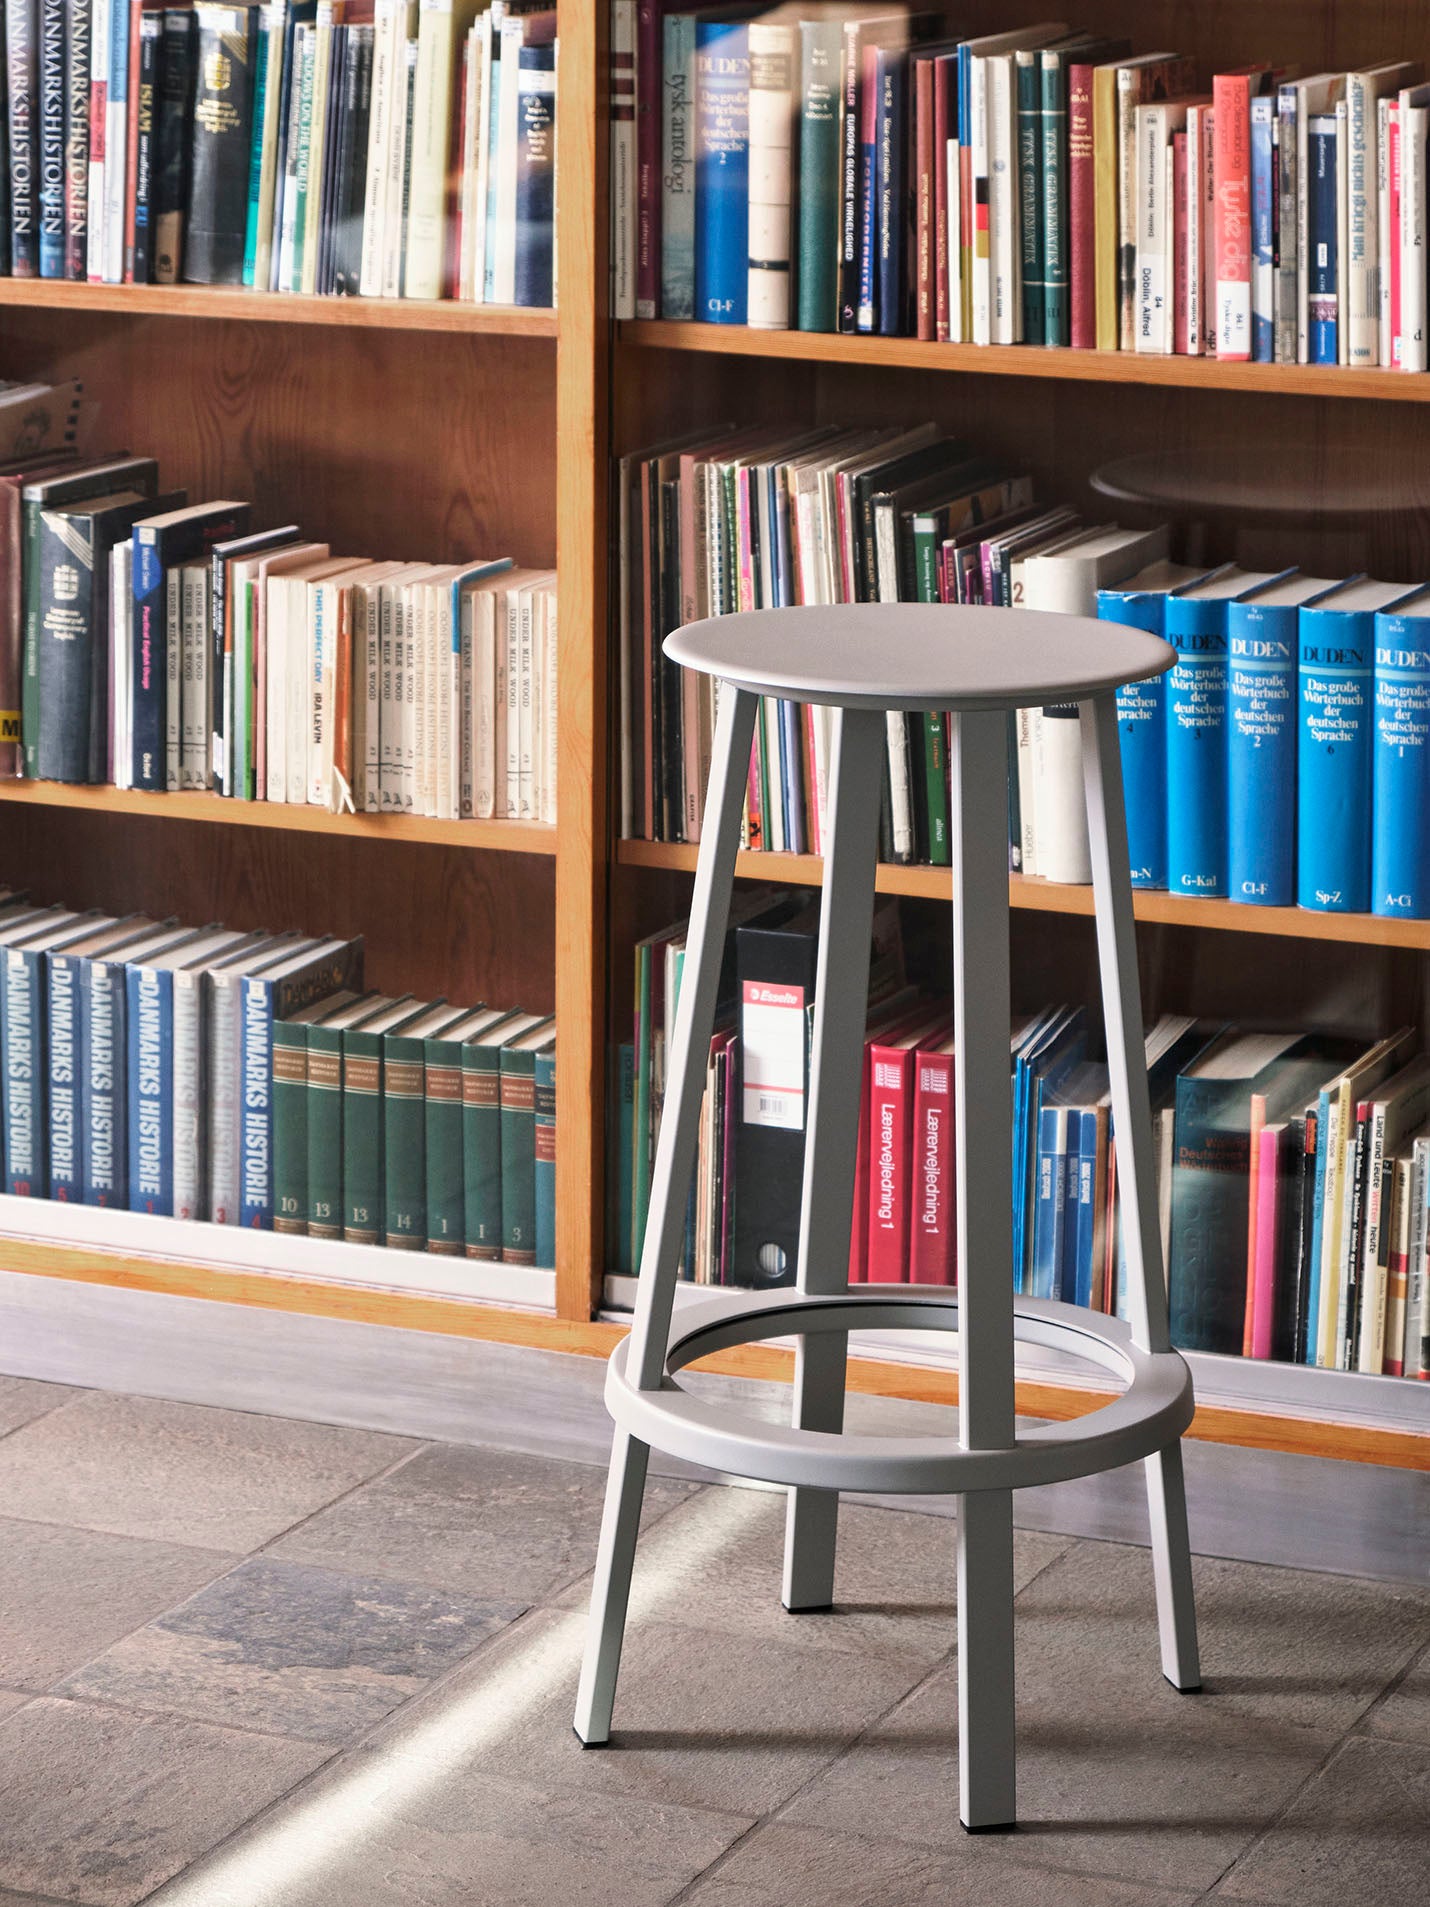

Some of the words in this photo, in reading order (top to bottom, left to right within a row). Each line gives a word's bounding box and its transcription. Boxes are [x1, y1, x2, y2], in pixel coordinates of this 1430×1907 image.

[665, 74, 689, 112] tysk
[139, 84, 152, 131] ISLAM
[301, 103, 312, 122] ON
[846, 114, 855, 156] EUROPAS
[1023, 128, 1035, 166] TYSK
[1045, 128, 1058, 166] TYSK
[664, 117, 693, 194] antologi
[1318, 135, 1326, 178] Mauersegler
[297, 154, 310, 193] WORLD
[845, 158, 855, 198] GLOBALE
[136, 206, 148, 227] EU
[1023, 171, 1036, 264] GRAMMATIK
[1046, 171, 1059, 265] GRAMMATIK
[1222, 175, 1248, 238] Tyske
[845, 201, 854, 260] VIRKELIGHED
[861, 156, 871, 306] POSTMODERNITET
[1222, 242, 1248, 280] dig
[1154, 296, 1163, 309] 84
[1141, 306, 1151, 336] Alfred
[168, 583, 177, 617] UNDER
[195, 583, 203, 617] UNDER
[314, 588, 323, 612] THIS
[1013, 581, 1025, 604] 2
[142, 606, 151, 638] Practical
[368, 602, 377, 636] UNDER
[383, 601, 391, 635] UNDER
[395, 603, 403, 637] UNDER
[509, 608, 517, 642] UNDER
[522, 608, 530, 642] UNDER
[168, 623, 177, 647] MILK
[195, 623, 203, 647] MILK
[314, 615, 322, 660] PERFECT
[1169, 632, 1227, 650] DUDEN
[140, 640, 151, 665] English
[368, 640, 377, 665] MILK
[383, 640, 391, 665] MILK
[395, 642, 403, 667] MILK
[463, 635, 471, 670] CRANE
[509, 648, 517, 672] MILK
[522, 648, 530, 672] MILK
[1231, 638, 1290, 658] DUDEN
[1303, 645, 1364, 664] DUDEN
[141, 666, 151, 689] Usage
[168, 652, 177, 681] WOOD
[195, 652, 203, 681] WOOD
[314, 662, 322, 683] DAY
[1174, 666, 1195, 678] Das
[1197, 667, 1225, 681] große
[368, 671, 377, 701] WOOD
[383, 671, 391, 700] WOOD
[395, 672, 403, 701] WOOD
[509, 679, 517, 707] WOOD
[522, 679, 530, 707] WOOD
[1123, 685, 1139, 696] der
[1170, 677, 1230, 691] Wörterbuch
[1232, 685, 1290, 699] Wörterbuch
[1235, 672, 1257, 685] Das
[1258, 675, 1286, 690] große
[1307, 678, 1328, 691] Das
[1330, 680, 1360, 695] große
[1379, 682, 1400, 695] Das
[313, 692, 322, 711] IRA
[1117, 696, 1157, 708] utschen
[1174, 702, 1225, 714] deutschen
[1190, 692, 1208, 703] der
[1250, 698, 1268, 710] der
[1303, 690, 1364, 705] Wörterbuch
[1117, 708, 1152, 721] prache
[1178, 714, 1221, 727] Sprache
[1235, 709, 1285, 722] deutschen
[1307, 715, 1359, 729] deutschen
[1324, 705, 1342, 717] der
[1394, 709, 1412, 721] der
[3, 719, 18, 737] M
[313, 713, 322, 744] LEVIN
[1020, 708, 1030, 747] Themen
[1127, 723, 1133, 733] 4
[1194, 729, 1201, 739] 3
[1238, 722, 1279, 736] Sprache
[1311, 728, 1354, 742] Sprache
[1379, 719, 1429, 733] deutschen
[1382, 731, 1424, 745] Sprache
[1254, 736, 1261, 748] 2
[1327, 744, 1335, 755] 6
[1399, 746, 1404, 757] 1
[142, 753, 151, 779] Oxford
[935, 818, 943, 841] alinea
[1024, 824, 1033, 859] Hueber
[1181, 874, 1216, 887] G-Kal
[1241, 881, 1269, 895] Cl-F
[1315, 890, 1343, 905] Sp-Z
[1385, 894, 1412, 907] A-Ci
[760, 989, 798, 1005] Esselte
[7, 965, 32, 1080] DANMARKS
[51, 968, 73, 1083] DANMARKS
[90, 975, 113, 1090] DANMARKS
[138, 975, 160, 1096] DANMARKS
[245, 991, 268, 1109] DANMARKS
[9, 1082, 32, 1176] HISTORIE
[51, 1087, 73, 1182] HISTORIE
[1375, 1115, 1384, 1138] Land
[91, 1095, 113, 1191] HISTORIE
[139, 1100, 160, 1195] HISTORIE
[1327, 1132, 1336, 1159] Treppe
[1373, 1141, 1382, 1160] und
[245, 1112, 268, 1208] HISTORIE
[879, 1103, 895, 1220] Lærervejledning
[924, 1108, 941, 1225] Lærervejledning
[1372, 1162, 1382, 1188] Leute
[13, 1181, 30, 1198] 10
[217, 1207, 226, 1223] 3
[281, 1197, 298, 1214] 10
[316, 1202, 330, 1218] 13
[353, 1208, 368, 1222] 13
[1370, 1191, 1380, 1224] Witten
[397, 1213, 412, 1228] 14
[441, 1218, 448, 1234] 1
[479, 1224, 485, 1238] 1
[881, 1222, 894, 1230] 1
[512, 1227, 522, 1242] 3
[1368, 1226, 1378, 1254] heute
